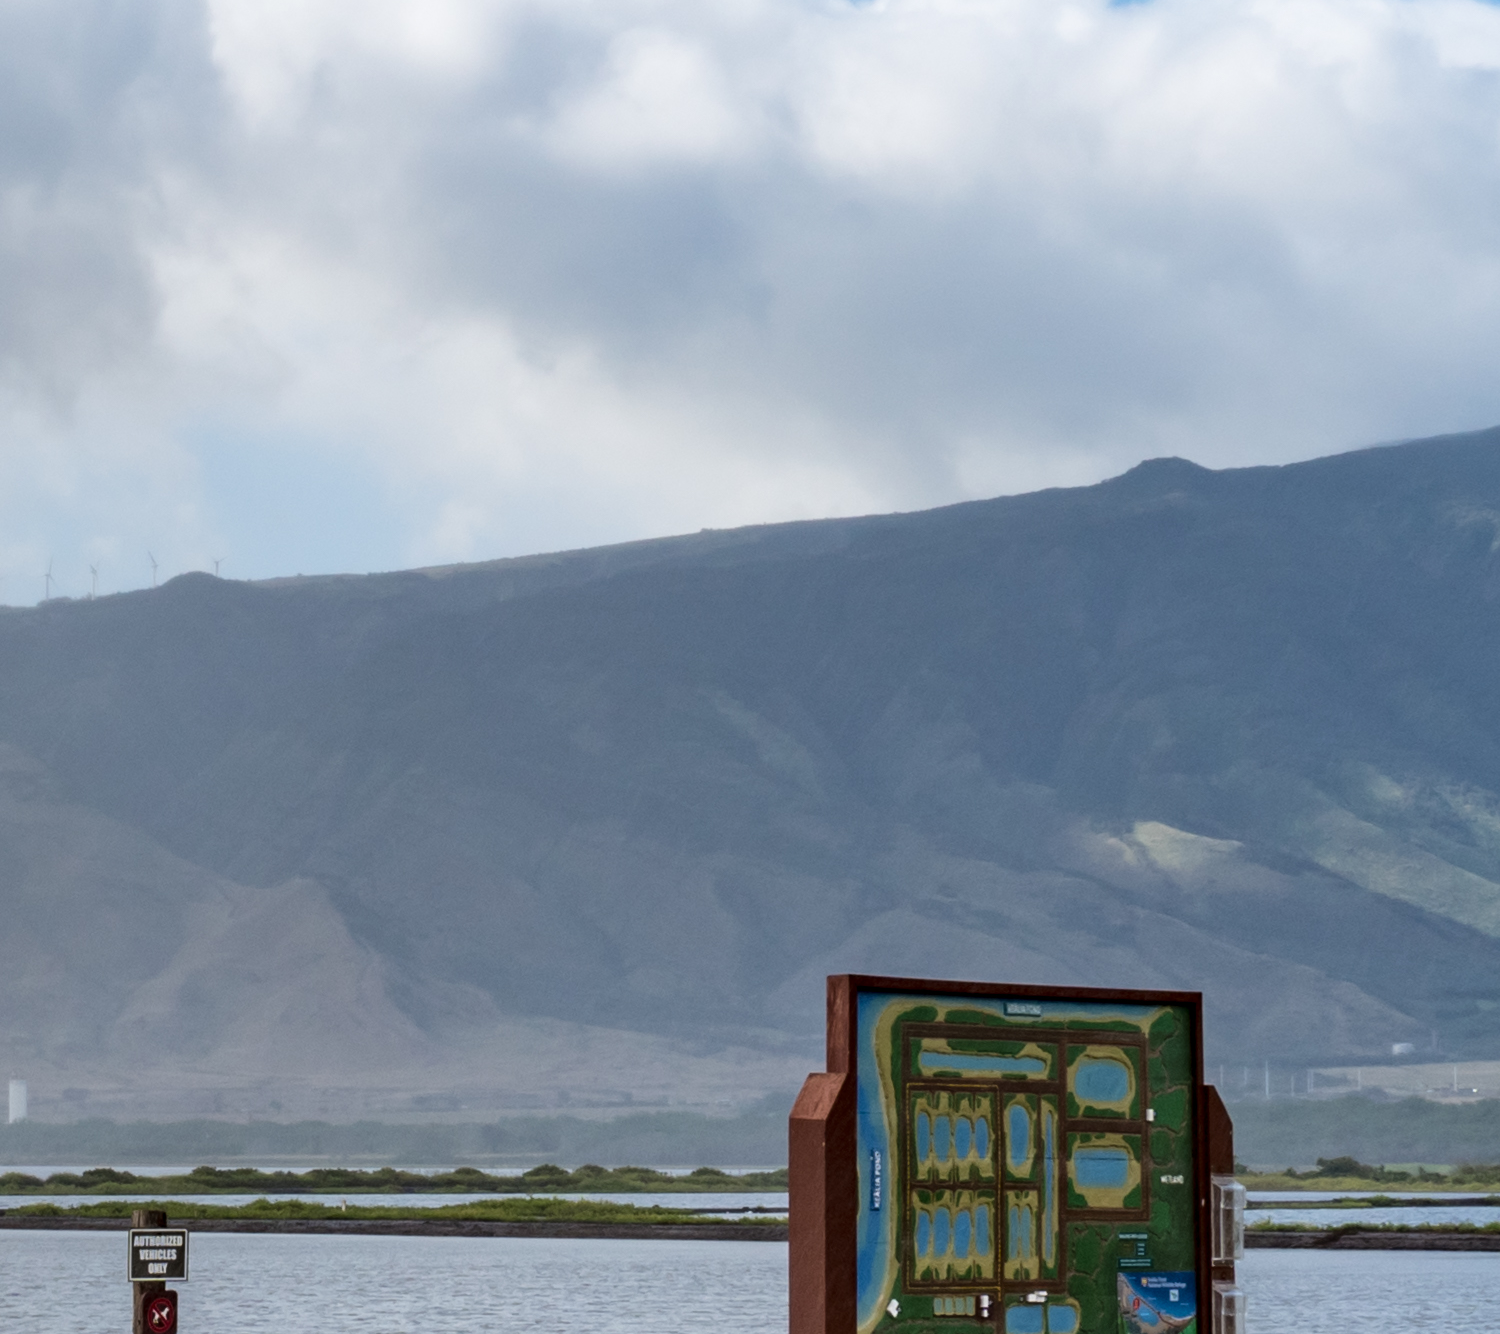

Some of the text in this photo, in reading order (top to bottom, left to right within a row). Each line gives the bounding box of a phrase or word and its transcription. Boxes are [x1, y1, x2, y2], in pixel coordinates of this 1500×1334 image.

[133, 1235, 183, 1247] AUTHORIZED
[139, 1249, 177, 1260] VEHICLES
[147, 1262, 168, 1274] ONLY
